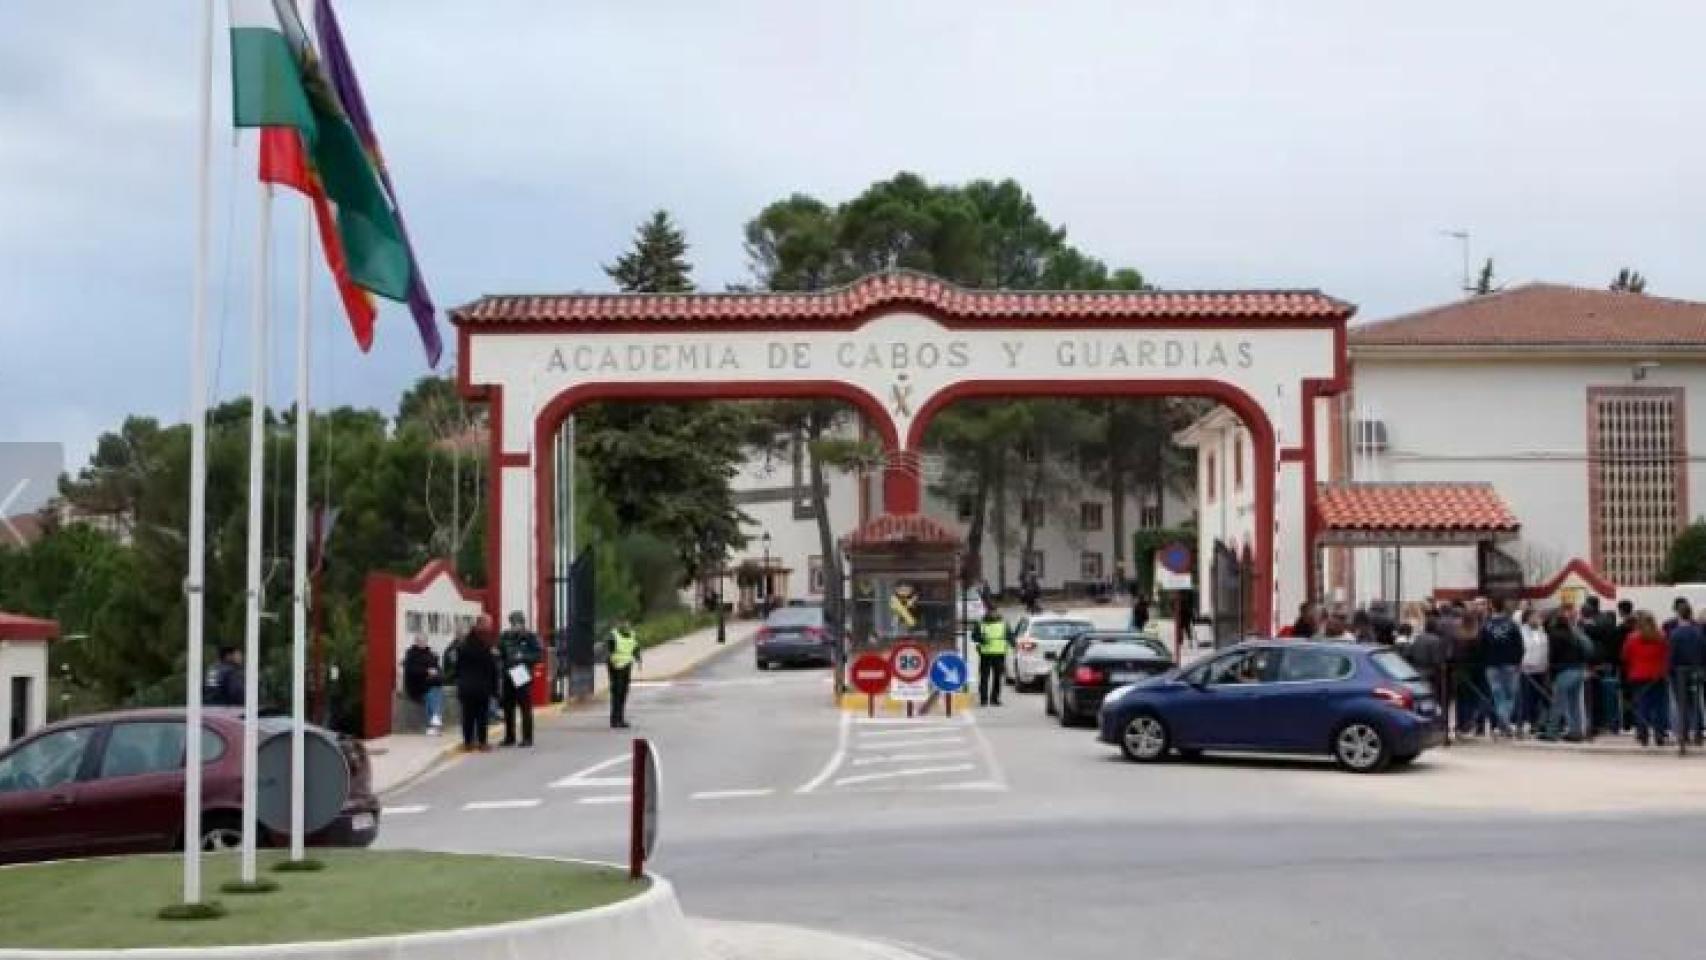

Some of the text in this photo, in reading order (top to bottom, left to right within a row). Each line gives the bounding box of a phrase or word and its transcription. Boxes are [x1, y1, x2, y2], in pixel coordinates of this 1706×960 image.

[546, 340, 1254, 372] ACADEMIA DE CABOS Y GUARDIAS
